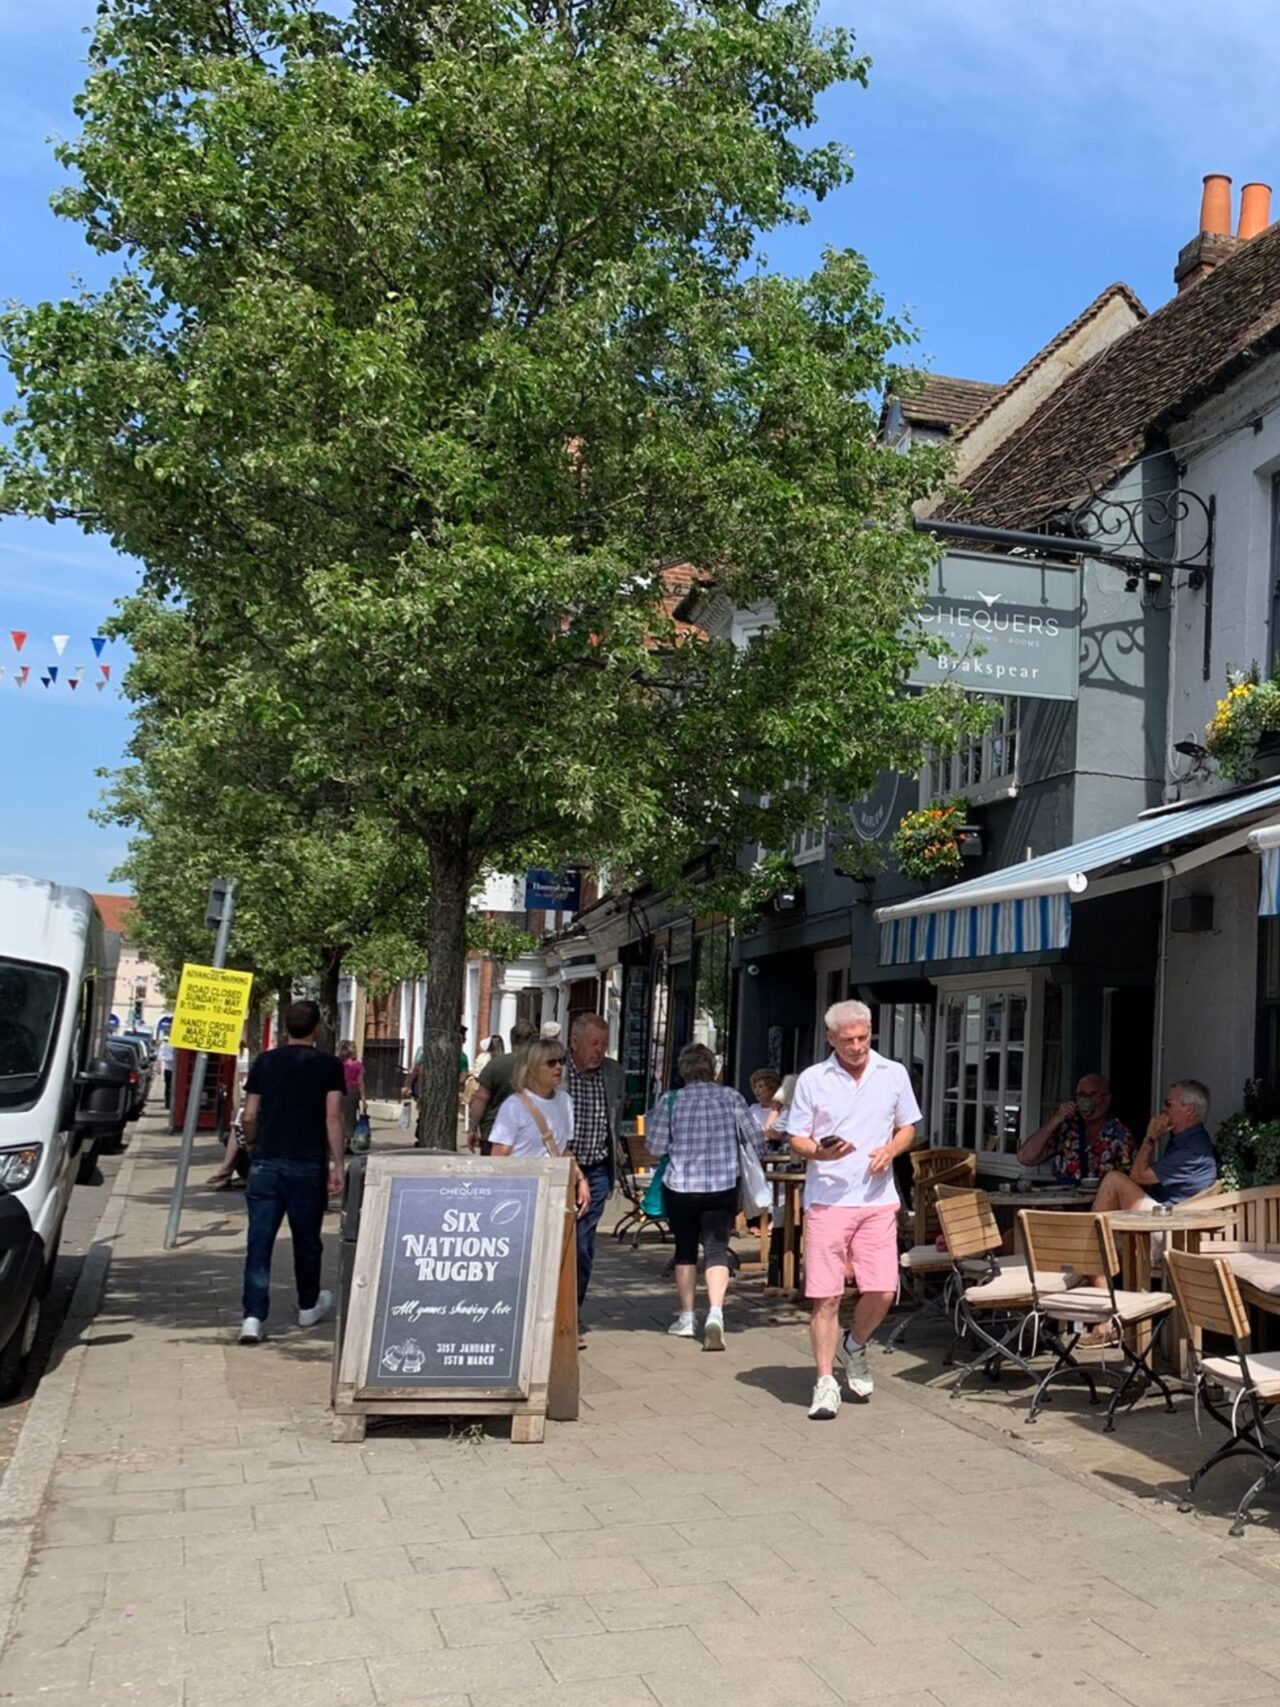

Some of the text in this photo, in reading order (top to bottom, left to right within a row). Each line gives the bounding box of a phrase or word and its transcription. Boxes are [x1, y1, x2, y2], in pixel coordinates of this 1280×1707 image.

[918, 604, 1059, 637] CHEQUERS
[938, 655, 1040, 679] Brakspear
[186, 983, 243, 999] ROAD CLOSED
[225, 998, 241, 1007] MAY
[209, 1020, 236, 1032] CROSS
[181, 1034, 228, 1048] ROAD RACE
[440, 1187, 492, 1196] CHEQUERS
[402, 1234, 510, 1257] NATIONS
[414, 1257, 499, 1282] RUGBY
[391, 1300, 420, 1316] All
[408, 1305, 447, 1323] games
[491, 1300, 512, 1315] live
[460, 1343, 496, 1353] JANUARY
[467, 1355, 494, 1366] MARCH
